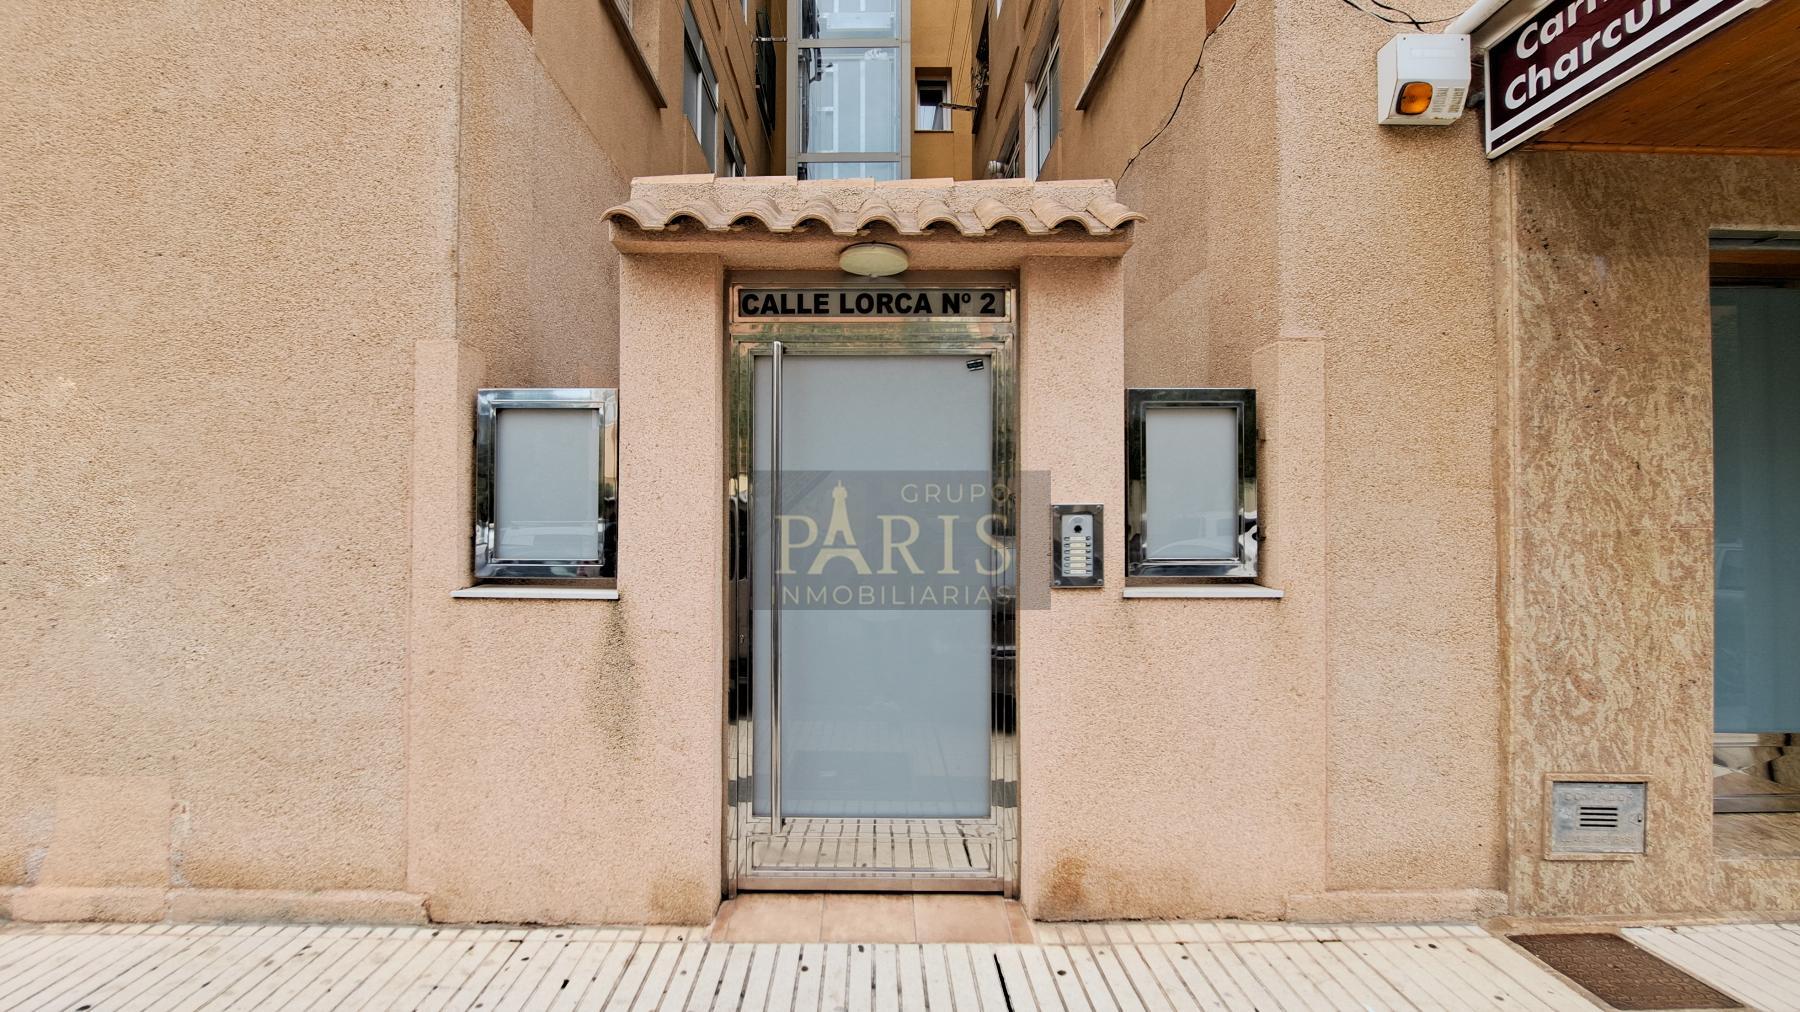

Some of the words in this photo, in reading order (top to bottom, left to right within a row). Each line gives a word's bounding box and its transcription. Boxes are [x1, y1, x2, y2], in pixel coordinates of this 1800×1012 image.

[741, 293, 829, 314] CALLE
[840, 293, 933, 314] LORCA
[980, 293, 996, 314] 2
